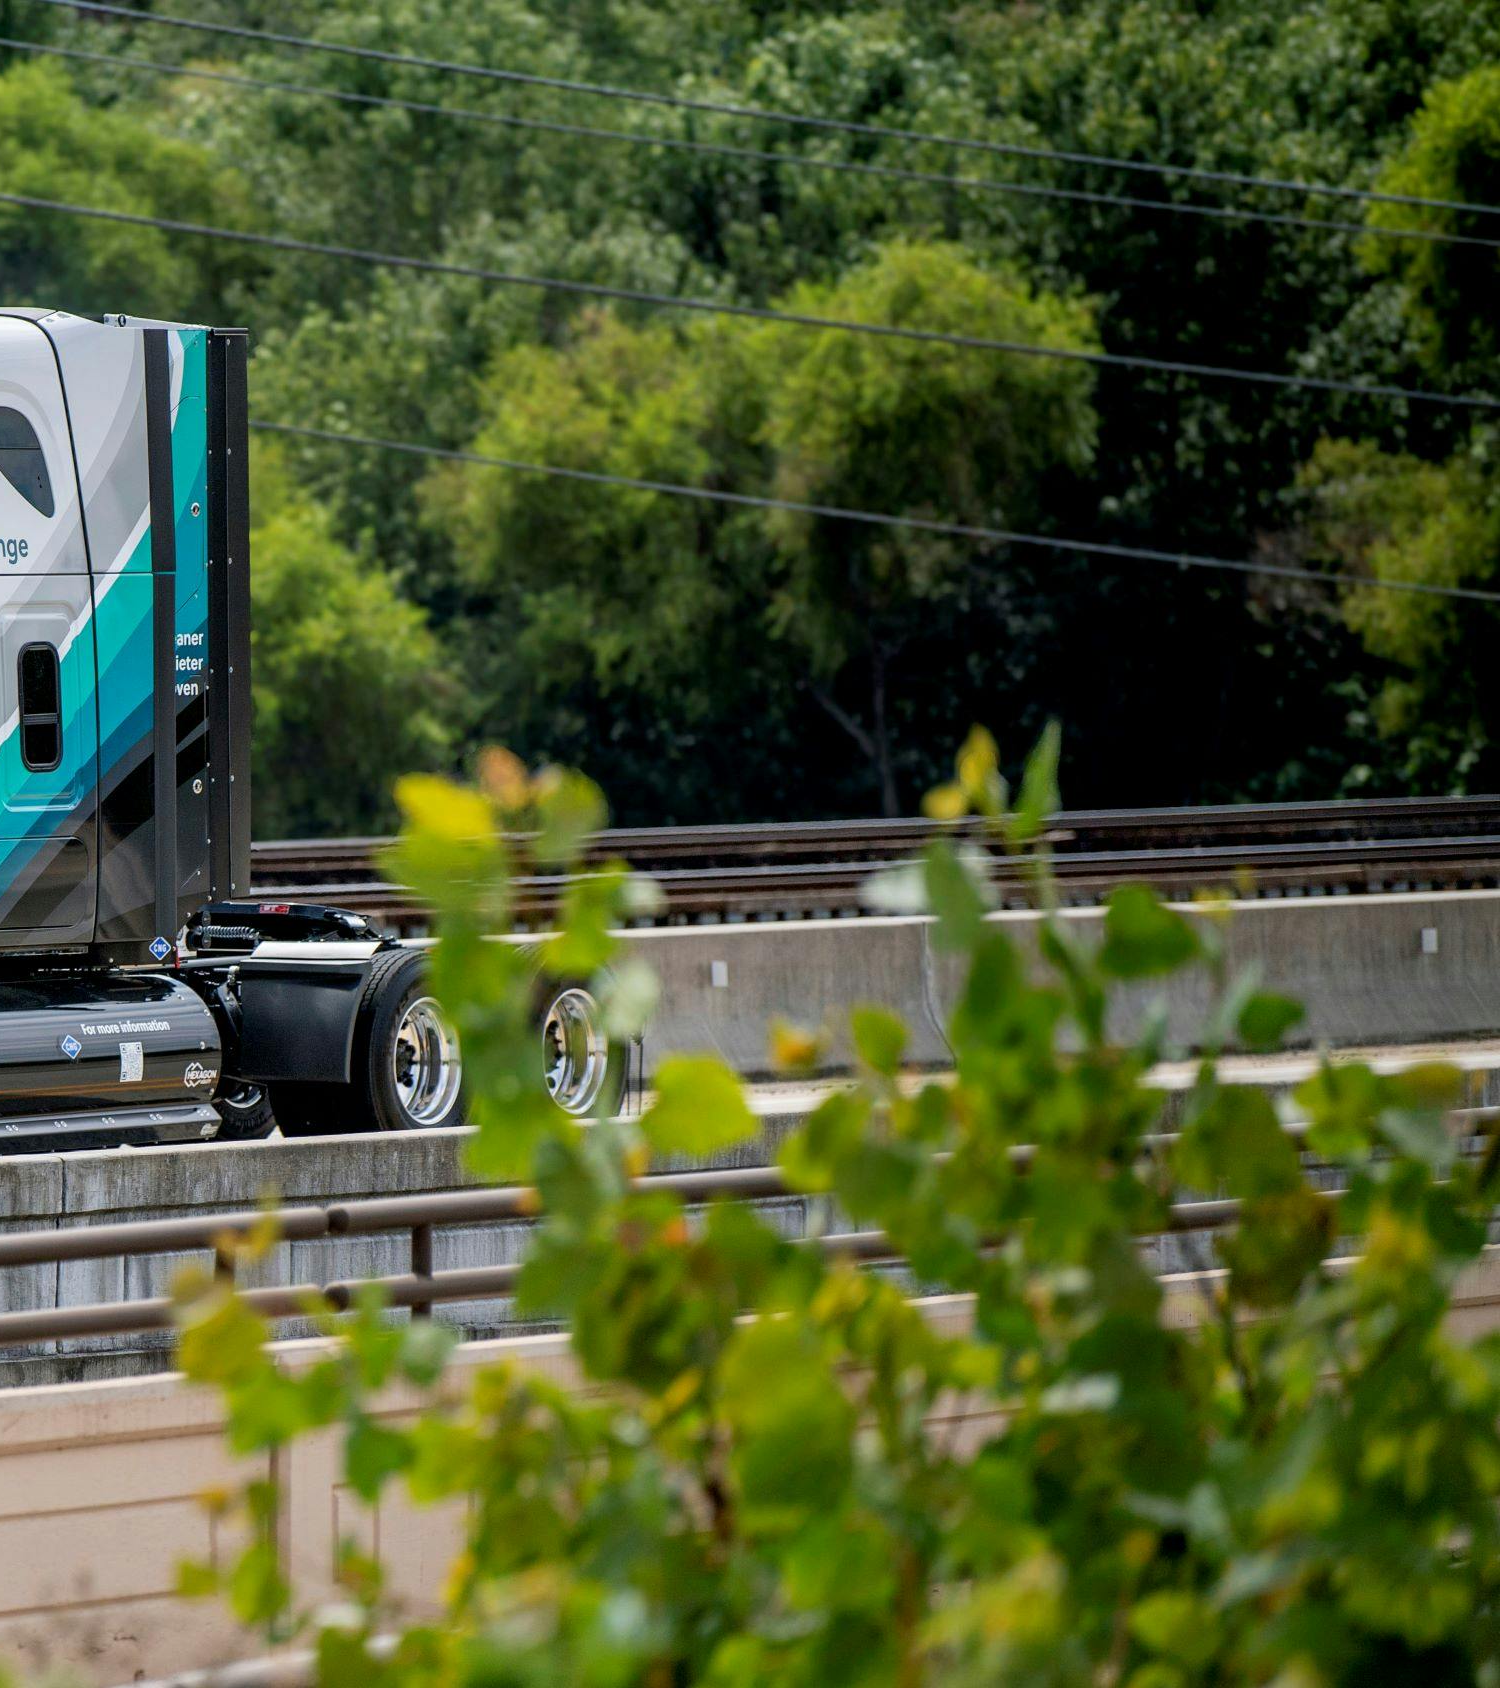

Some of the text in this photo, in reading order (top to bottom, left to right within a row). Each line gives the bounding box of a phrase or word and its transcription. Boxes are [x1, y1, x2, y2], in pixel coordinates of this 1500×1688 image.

[175, 632, 204, 646] aner
[175, 654, 204, 671] ieter
[174, 682, 199, 696] ven
[153, 944, 167, 953] CNG
[80, 1019, 171, 1035] For more information
[187, 1069, 217, 1080] HEXAGON
